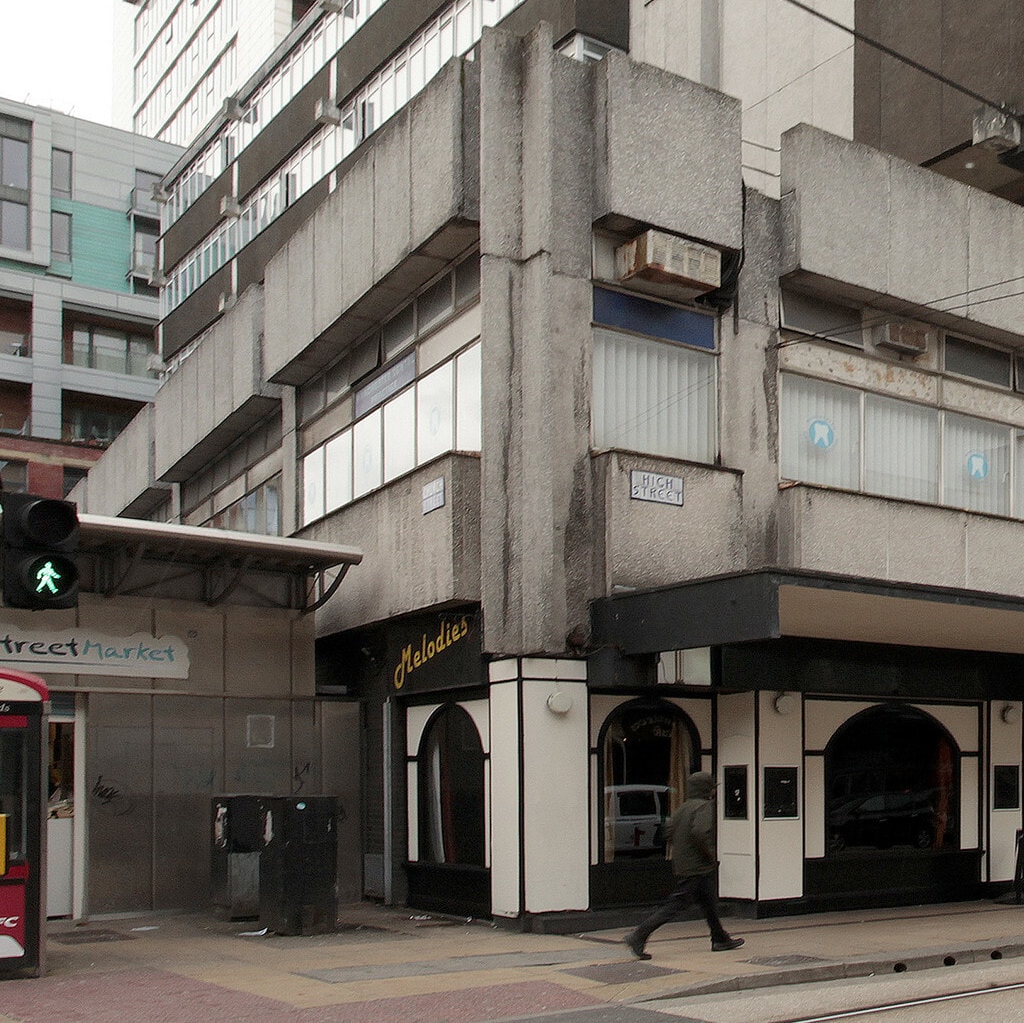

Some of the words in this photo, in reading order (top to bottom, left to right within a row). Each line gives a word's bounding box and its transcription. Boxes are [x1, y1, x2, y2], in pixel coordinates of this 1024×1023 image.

[642, 474, 673, 489] HIGH
[632, 484, 682, 502] STREET
[393, 615, 469, 690] Melodies
